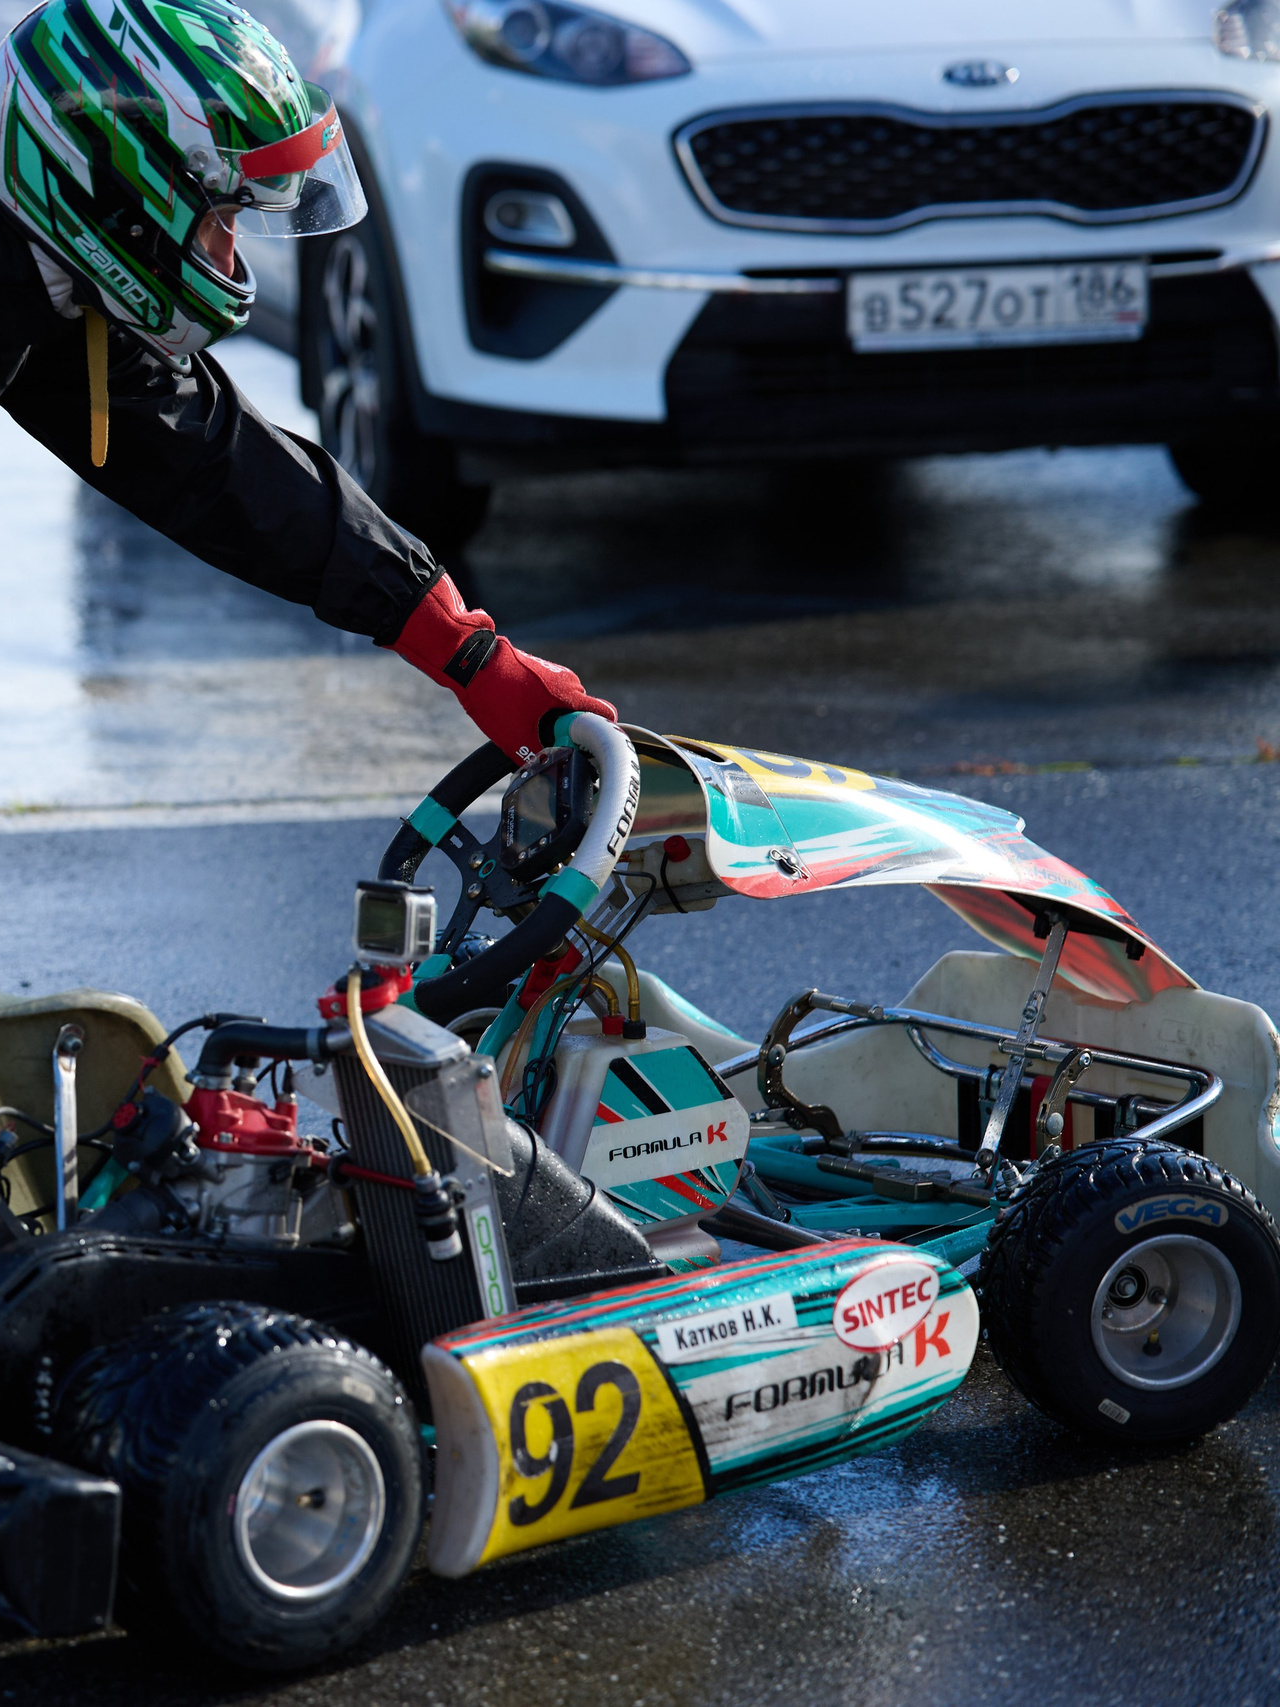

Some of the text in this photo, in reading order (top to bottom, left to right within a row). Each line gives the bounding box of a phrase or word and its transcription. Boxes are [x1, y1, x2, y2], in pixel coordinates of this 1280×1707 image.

[608, 1121, 728, 1162] FORMULA K
[1117, 1200, 1222, 1232] VEGA
[674, 1304, 782, 1351] Катков Н.К.
[842, 1276, 932, 1334] SINTEC
[914, 1311, 952, 1368] K
[508, 1360, 642, 1528] 92
